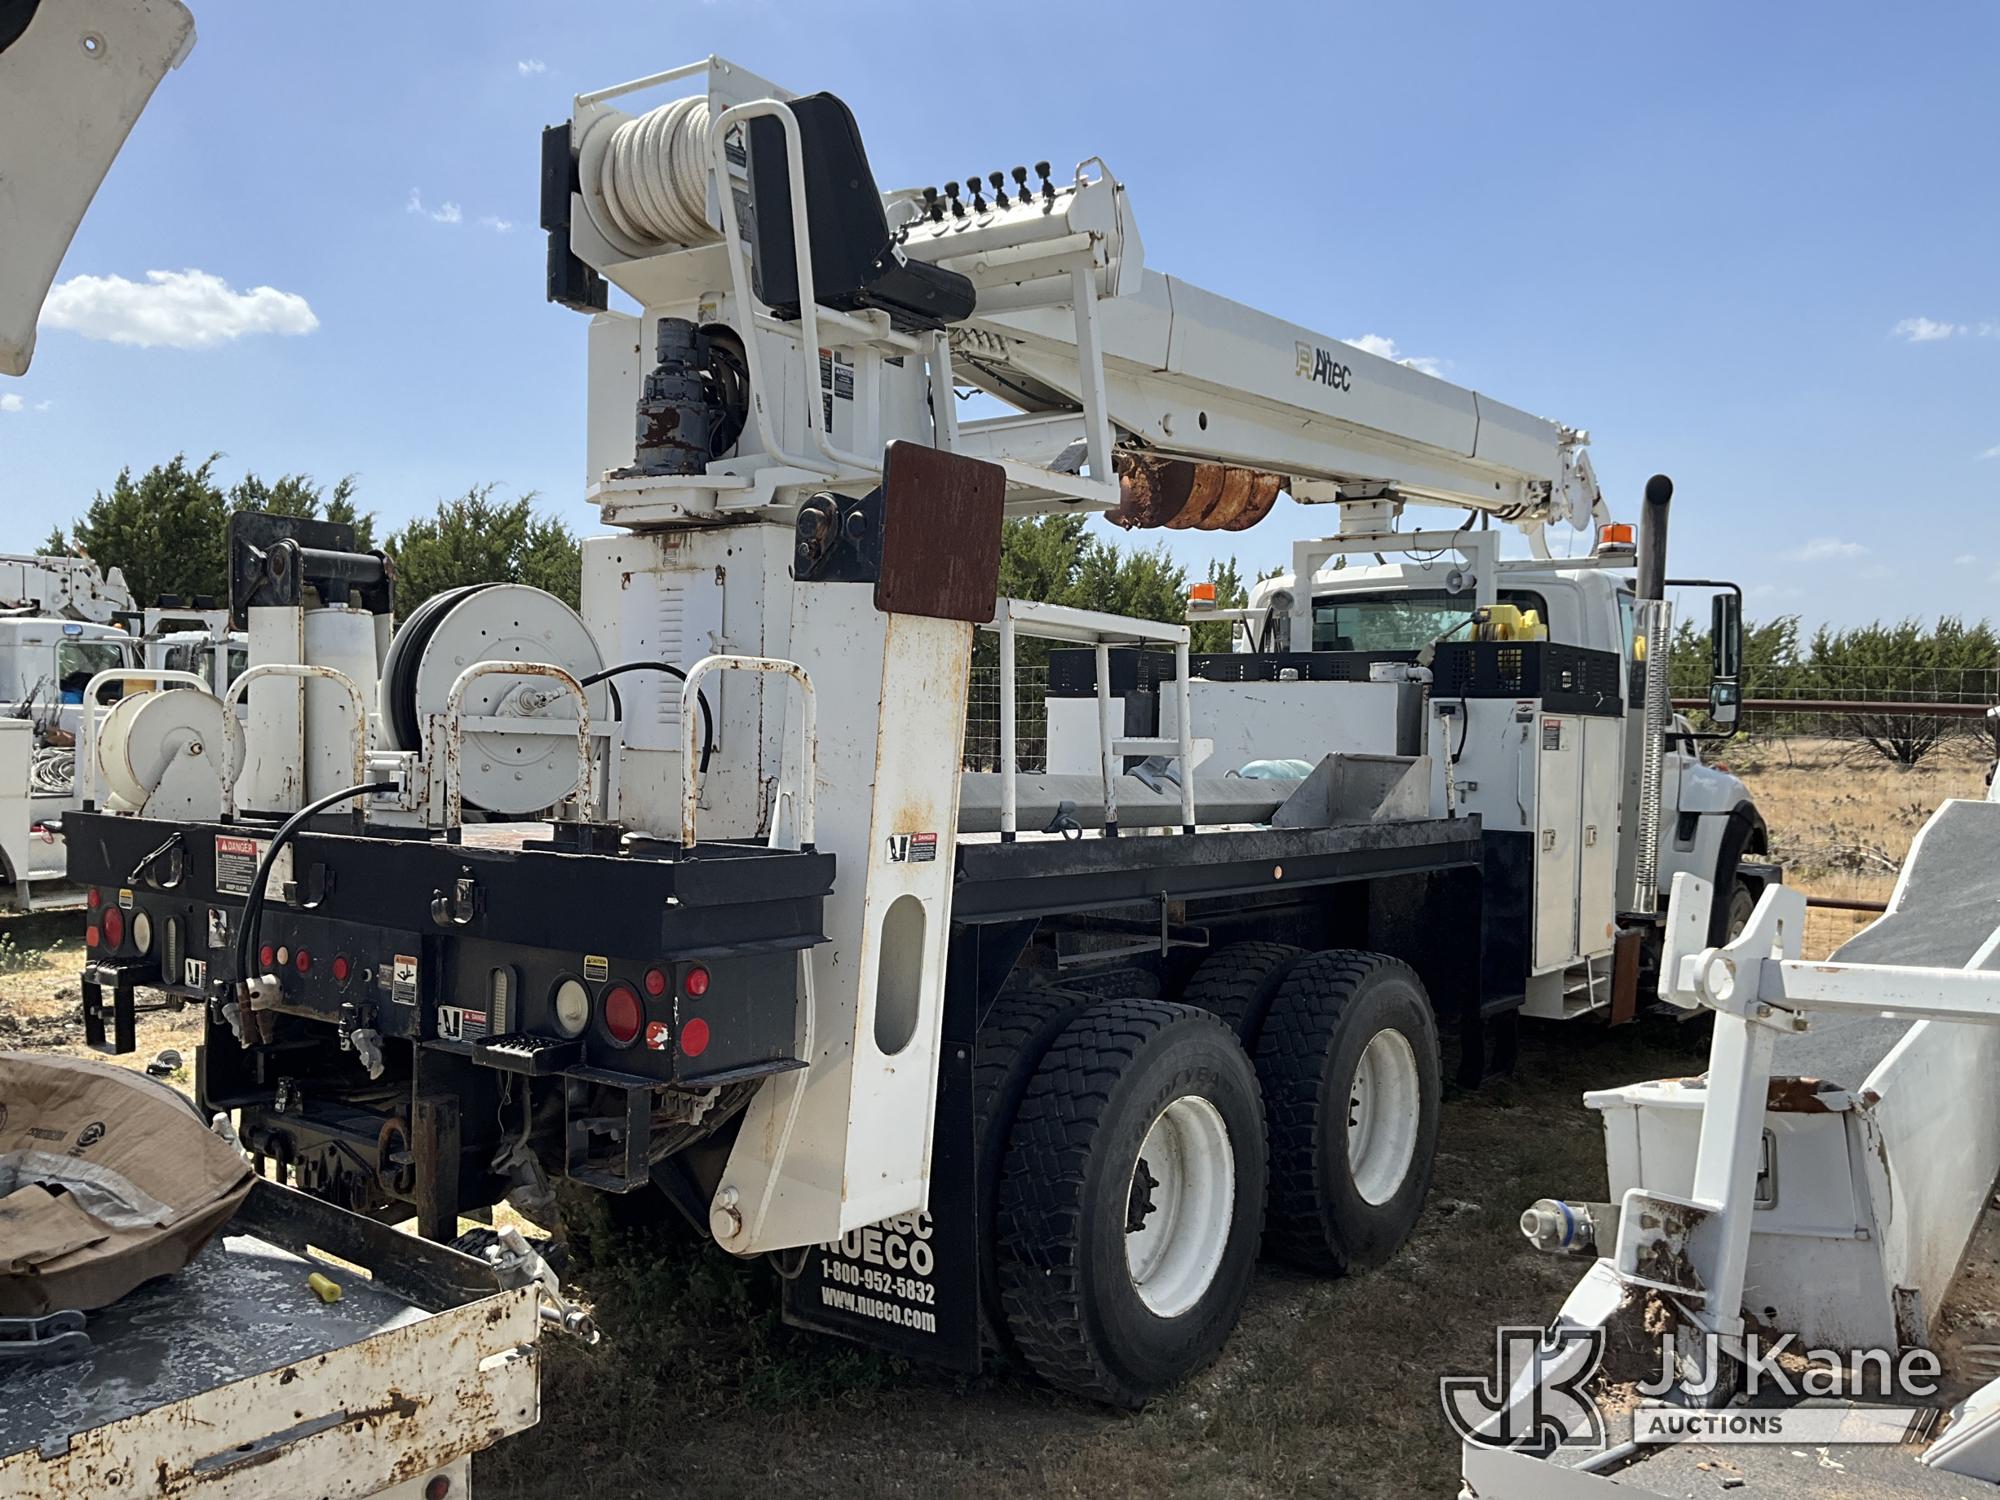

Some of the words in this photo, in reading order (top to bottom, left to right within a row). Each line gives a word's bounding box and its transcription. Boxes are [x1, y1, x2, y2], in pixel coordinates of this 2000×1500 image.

[1312, 348, 1352, 392] Altec
[227, 840, 253, 853] DANGER
[821, 1258, 935, 1304] 1-800-952-5832
[821, 1286, 936, 1333] www.nueco.com
